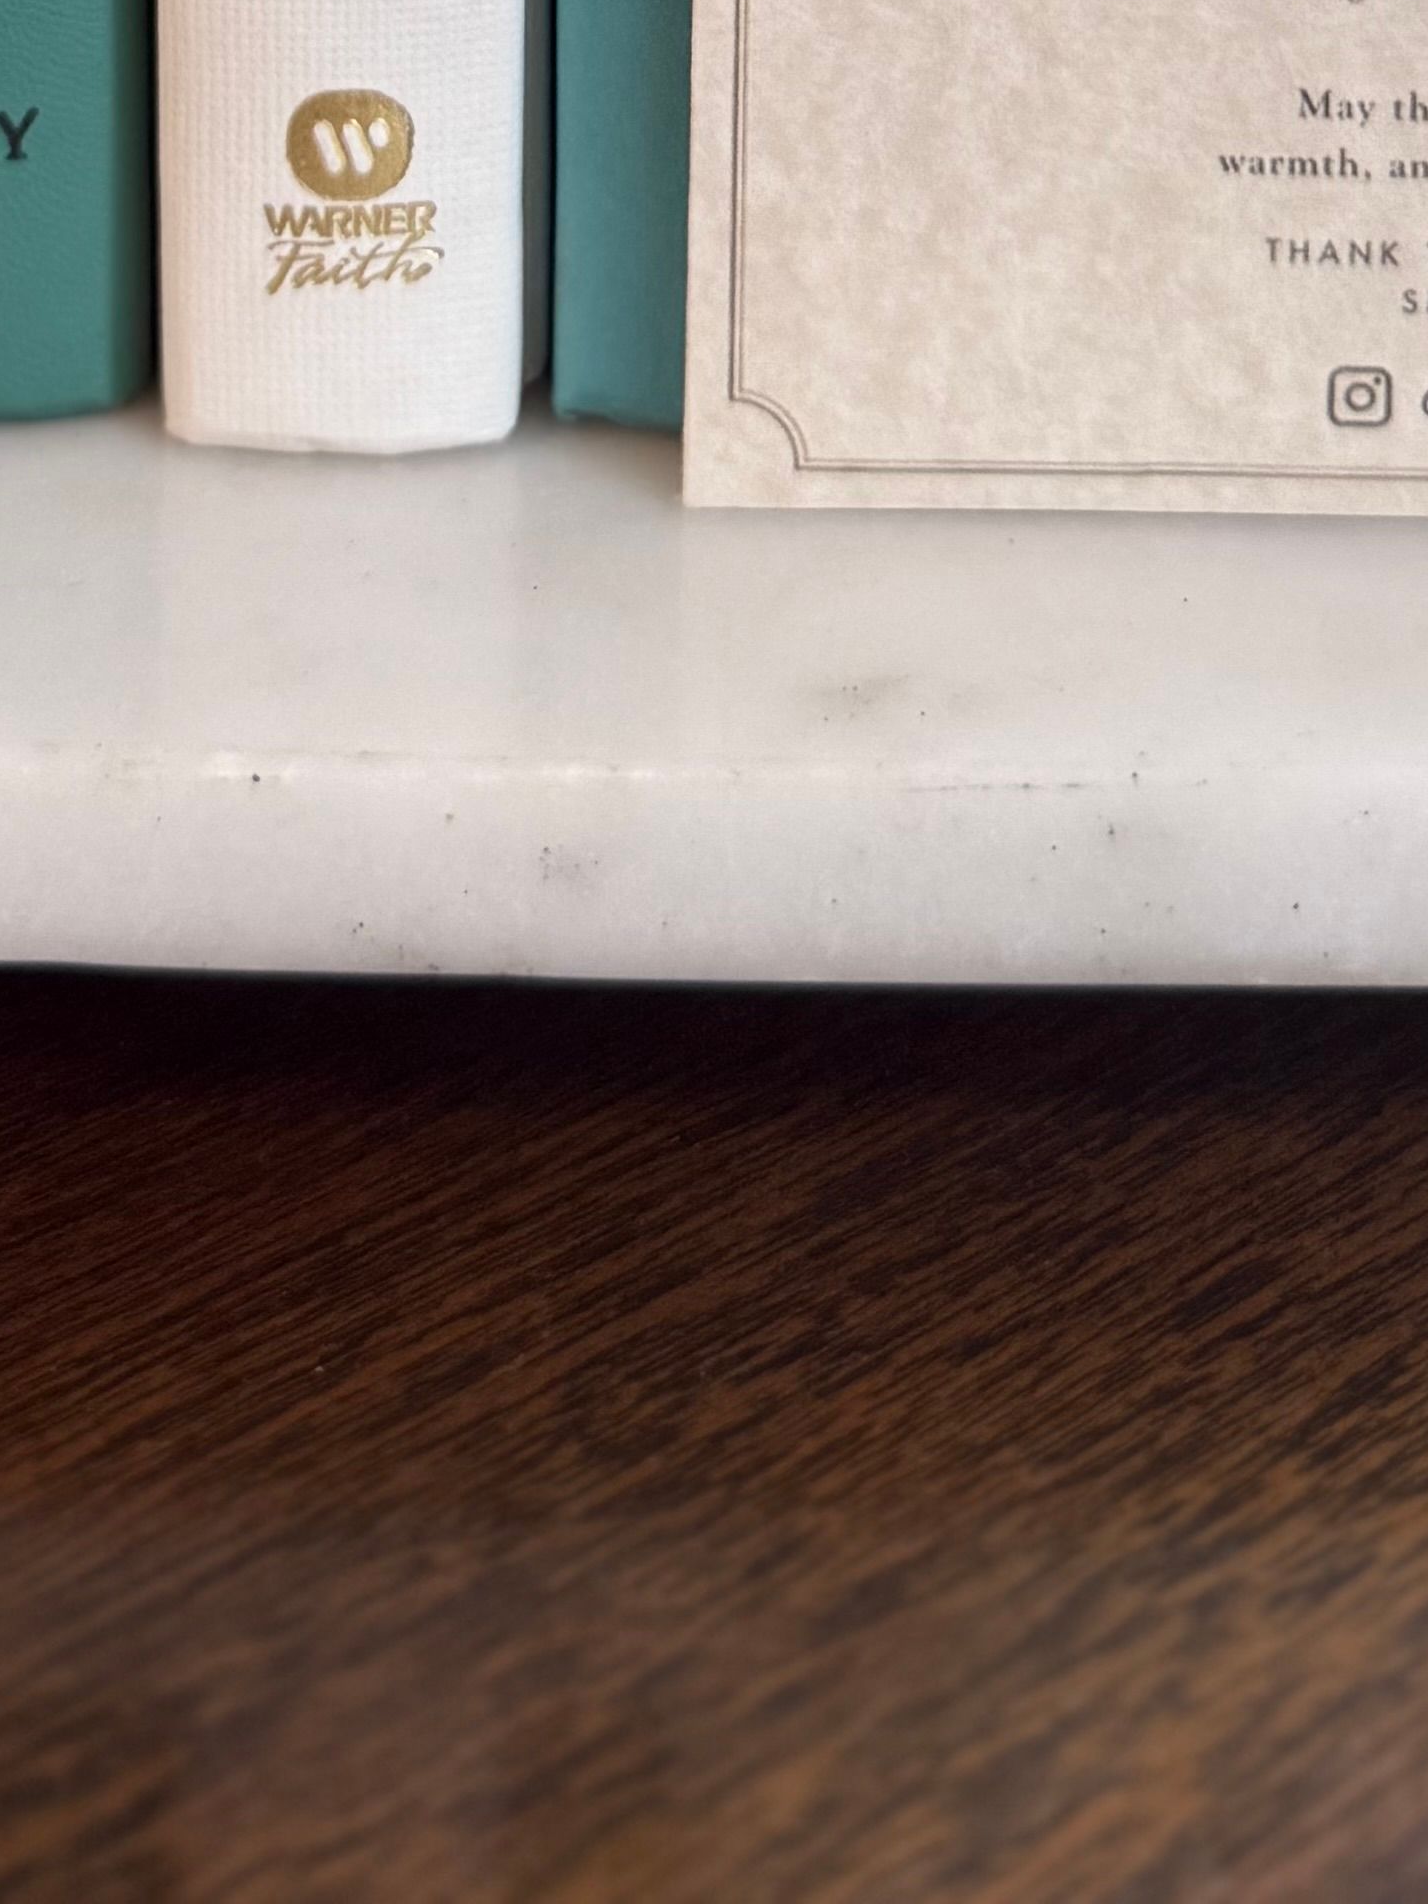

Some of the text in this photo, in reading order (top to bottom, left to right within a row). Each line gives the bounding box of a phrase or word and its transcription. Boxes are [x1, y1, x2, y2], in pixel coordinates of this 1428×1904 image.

[1298, 87, 1376, 129] May
[1217, 146, 1372, 182] warmth,
[264, 200, 438, 239] WARNER
[264, 232, 446, 295] Faith
[1265, 236, 1400, 269] THANK
